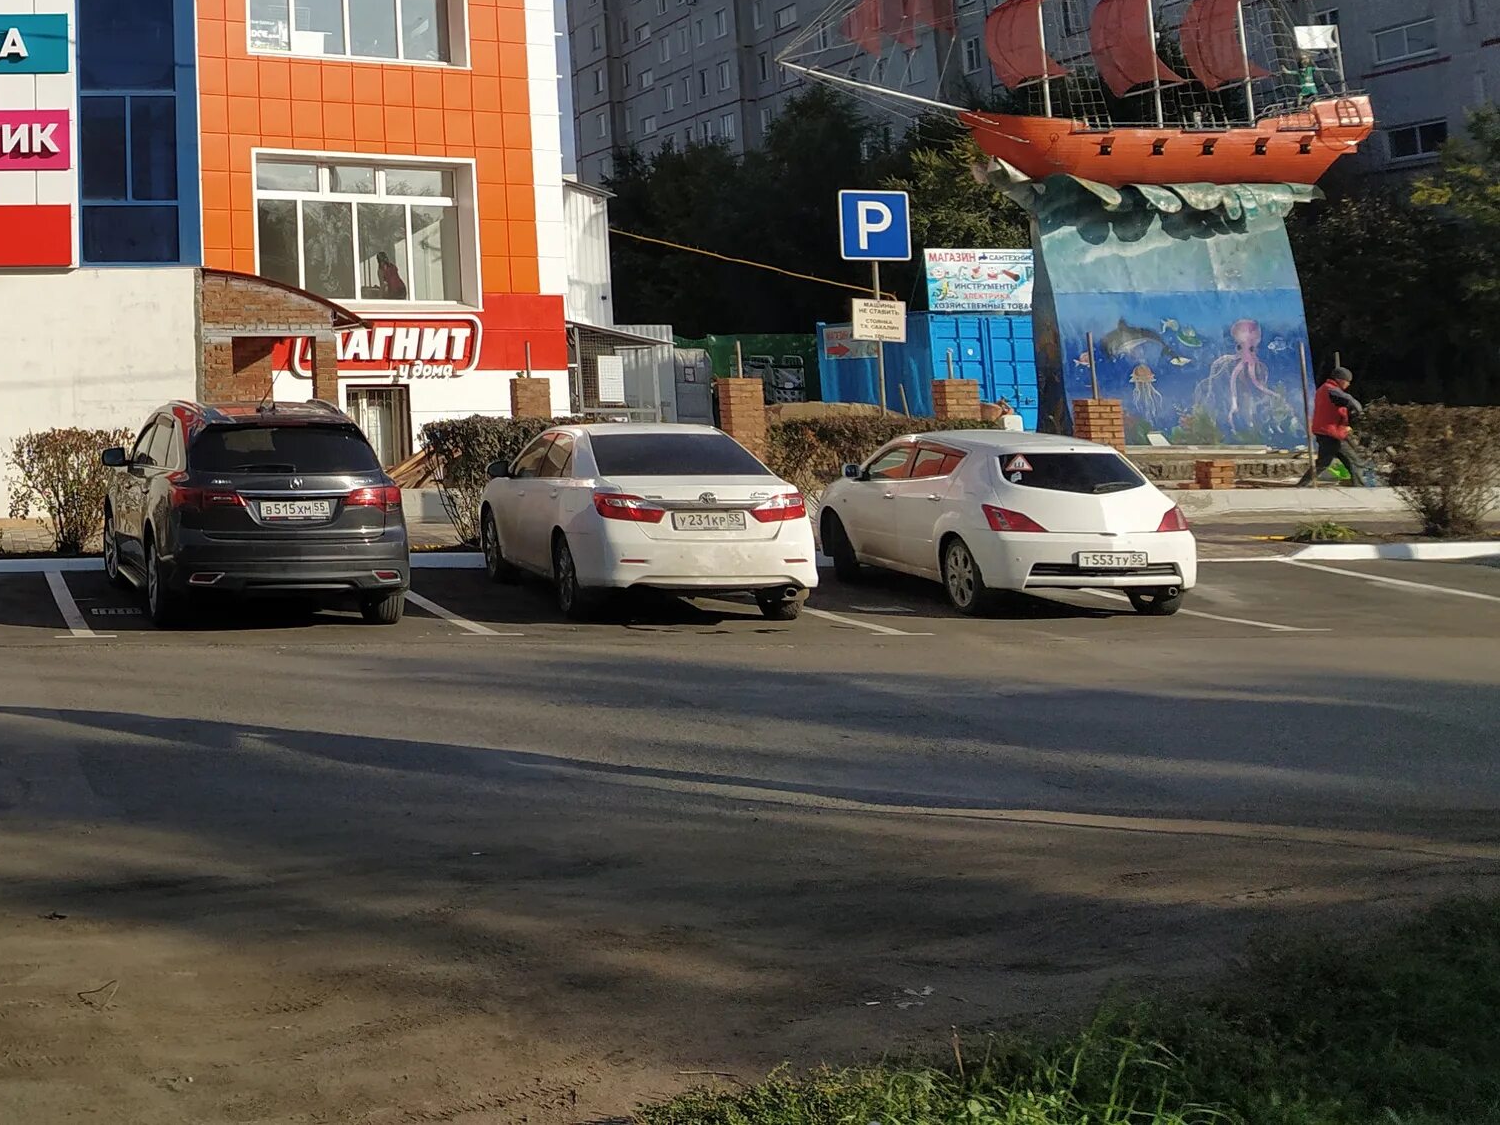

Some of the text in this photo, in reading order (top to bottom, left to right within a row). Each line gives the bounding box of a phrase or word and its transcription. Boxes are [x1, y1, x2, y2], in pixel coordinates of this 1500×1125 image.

[928, 252, 976, 263] МАГАЗИН
[954, 282, 1018, 290] ИНСТРУМЕНТЫ
[869, 308, 900, 316] СТАВИТЬ
[399, 360, 454, 379] у дома
